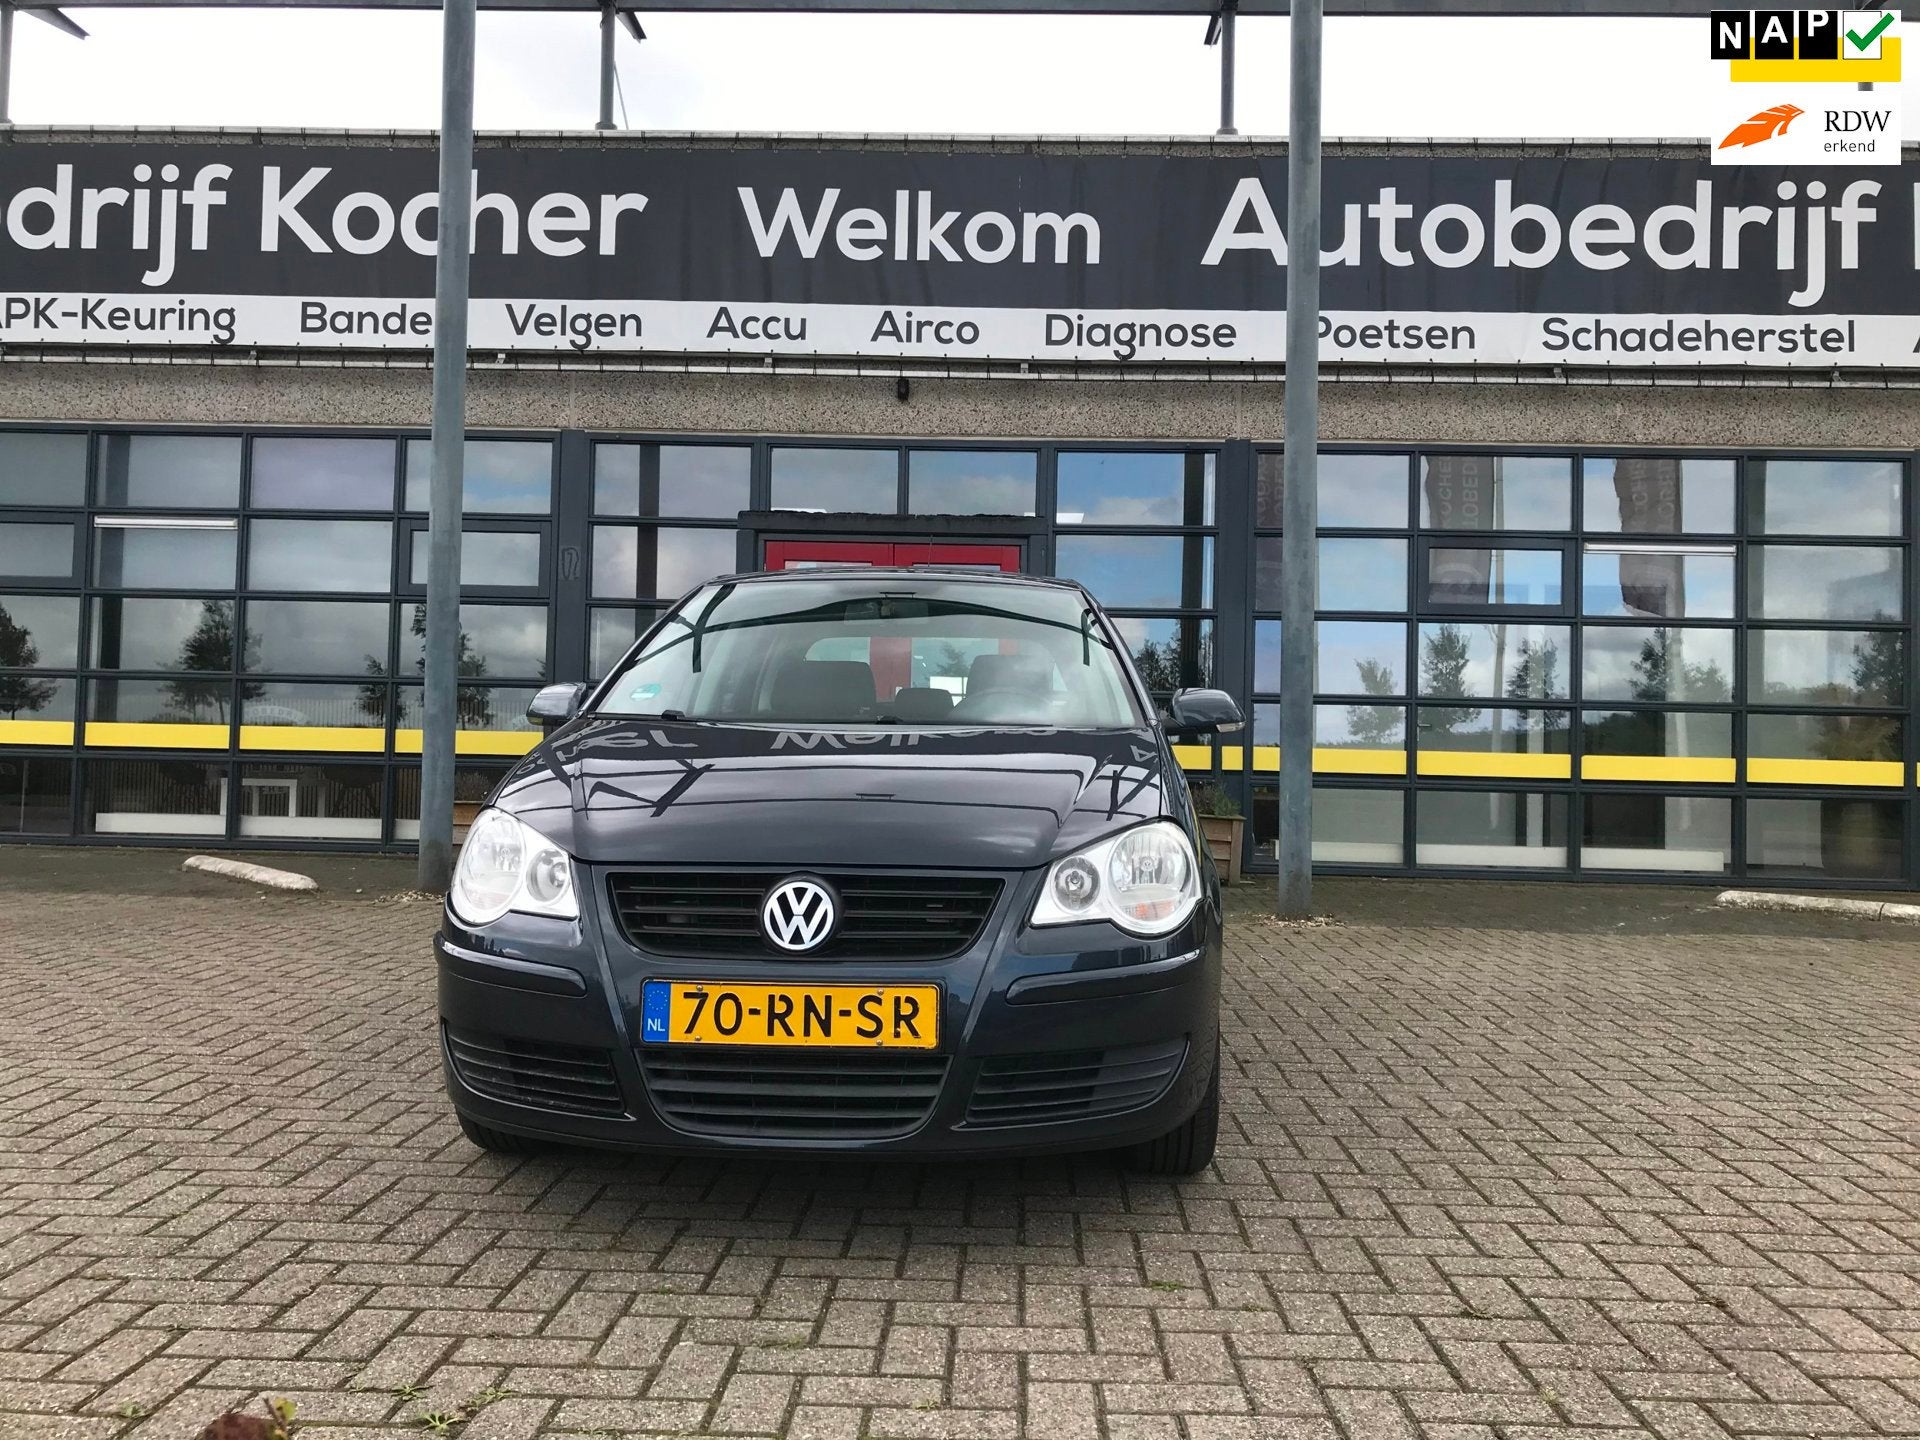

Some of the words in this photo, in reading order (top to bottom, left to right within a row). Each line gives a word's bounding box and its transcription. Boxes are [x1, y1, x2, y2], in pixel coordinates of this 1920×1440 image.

[0, 164, 233, 287] drijf
[261, 167, 649, 256] Kocher
[738, 187, 1100, 264] Welkom
[1201, 178, 1883, 308] Autobedrijf
[0, 297, 237, 345] PK-Keuring
[300, 302, 434, 335] Bande
[505, 304, 643, 352] Velgen
[706, 307, 807, 341] Accu
[871, 311, 980, 345] Airco
[1045, 314, 1237, 360] Diagnose
[1542, 317, 1856, 354] Schadeherstel
[647, 1018, 666, 1032] NL
[683, 991, 922, 1039] 70-RN-SR
